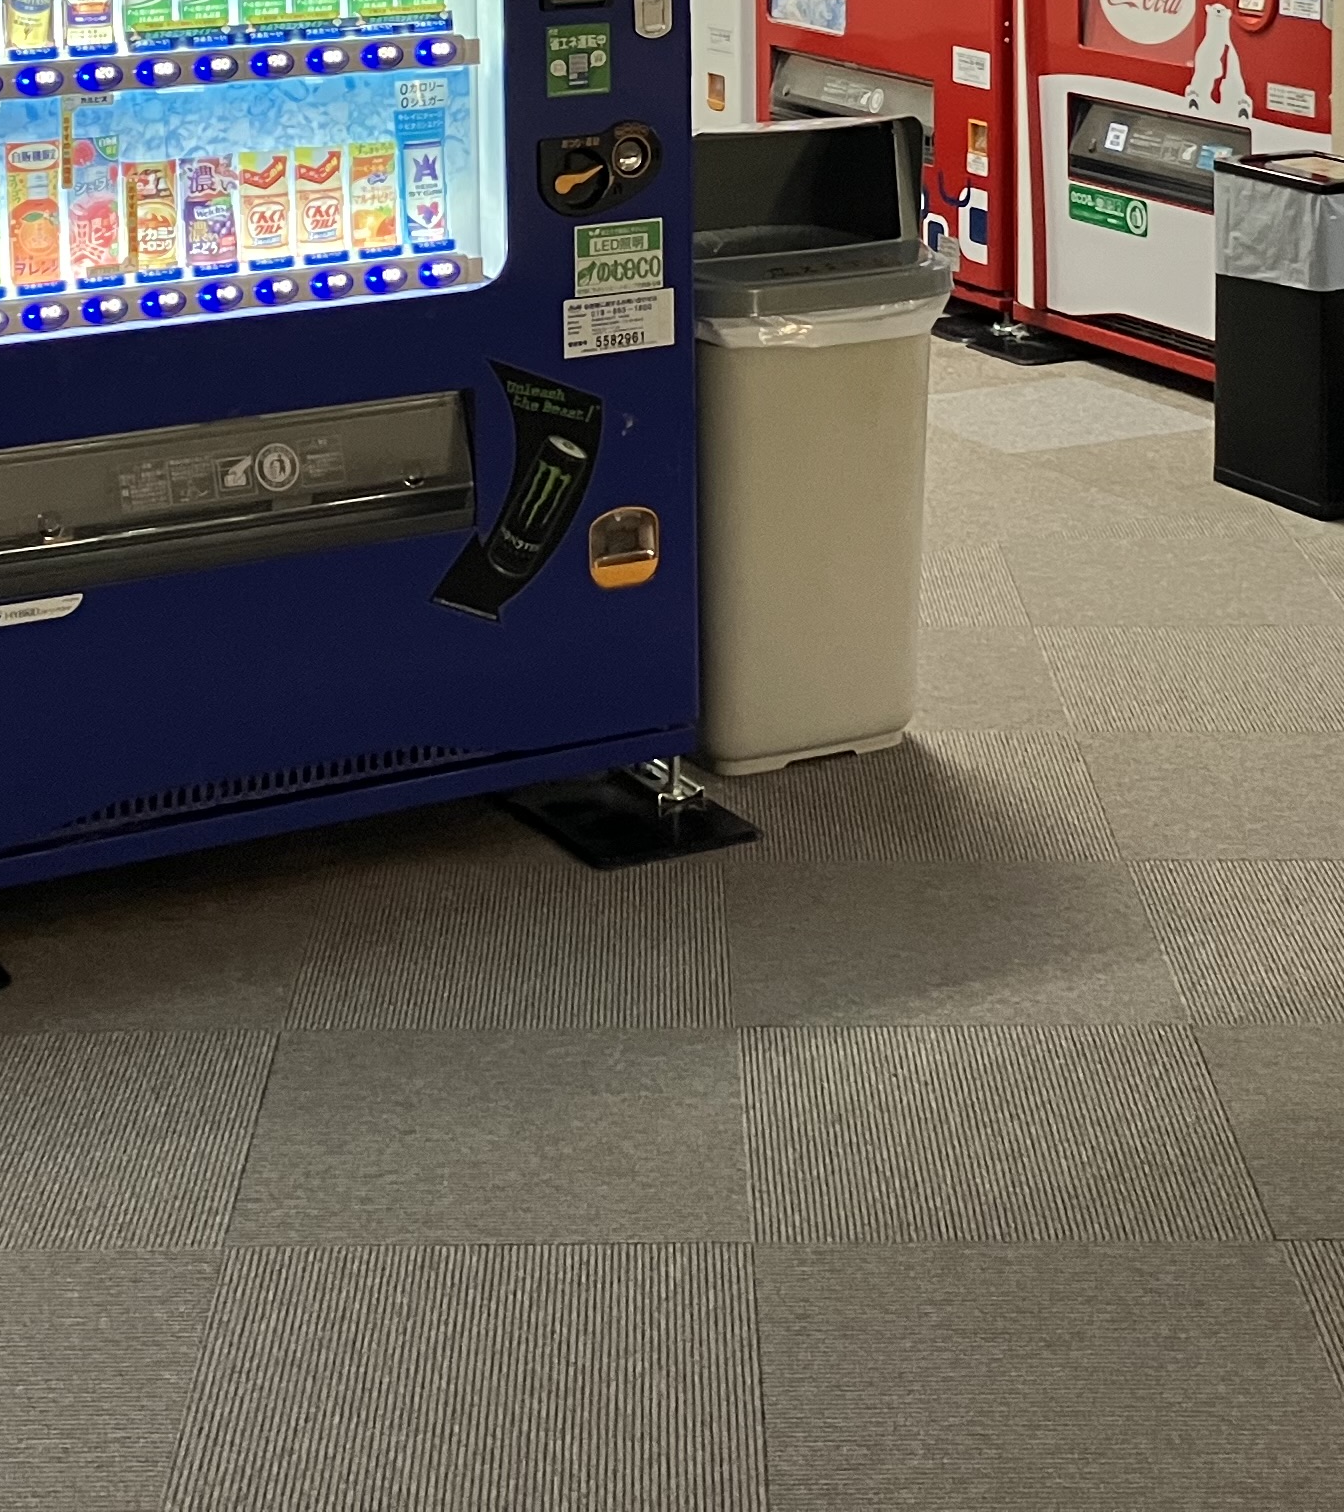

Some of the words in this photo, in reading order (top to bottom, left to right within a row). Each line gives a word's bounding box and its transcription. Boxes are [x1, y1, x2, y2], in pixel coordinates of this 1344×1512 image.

[399, 82, 446, 95] 0カロリー
[400, 95, 446, 109] 0シュガー
